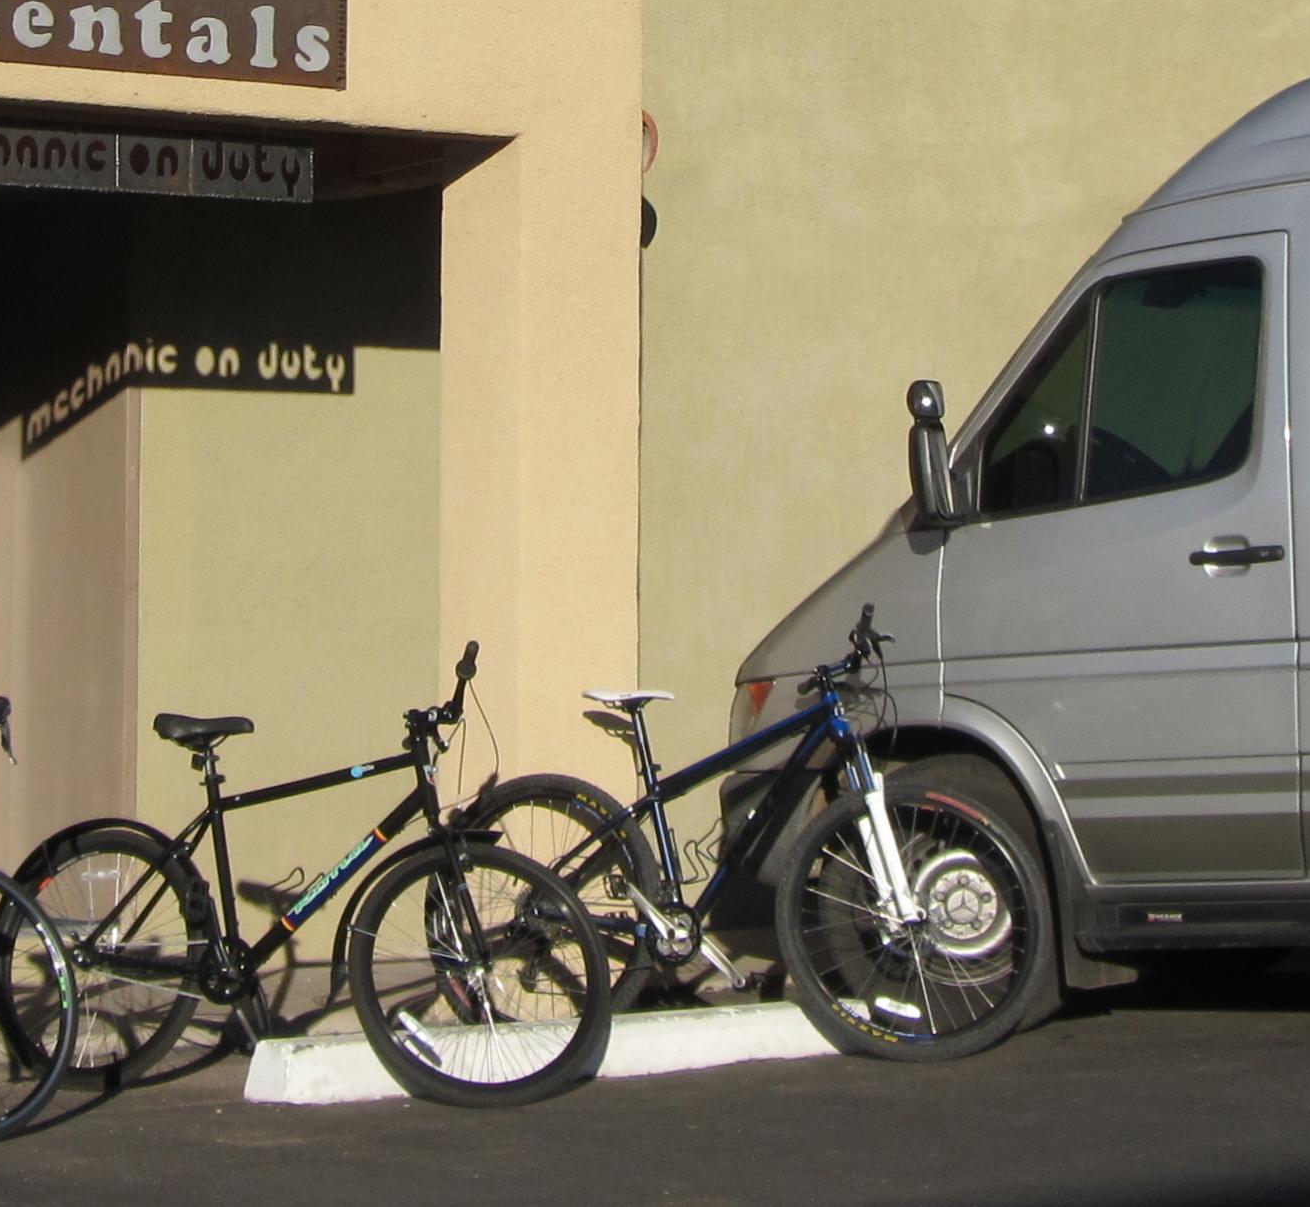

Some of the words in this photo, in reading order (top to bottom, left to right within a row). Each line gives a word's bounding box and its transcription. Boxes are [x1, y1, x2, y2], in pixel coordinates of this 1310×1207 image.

[128, 142, 179, 178] on
[201, 138, 301, 197] duty
[194, 345, 240, 378] on
[257, 341, 346, 393] duty
